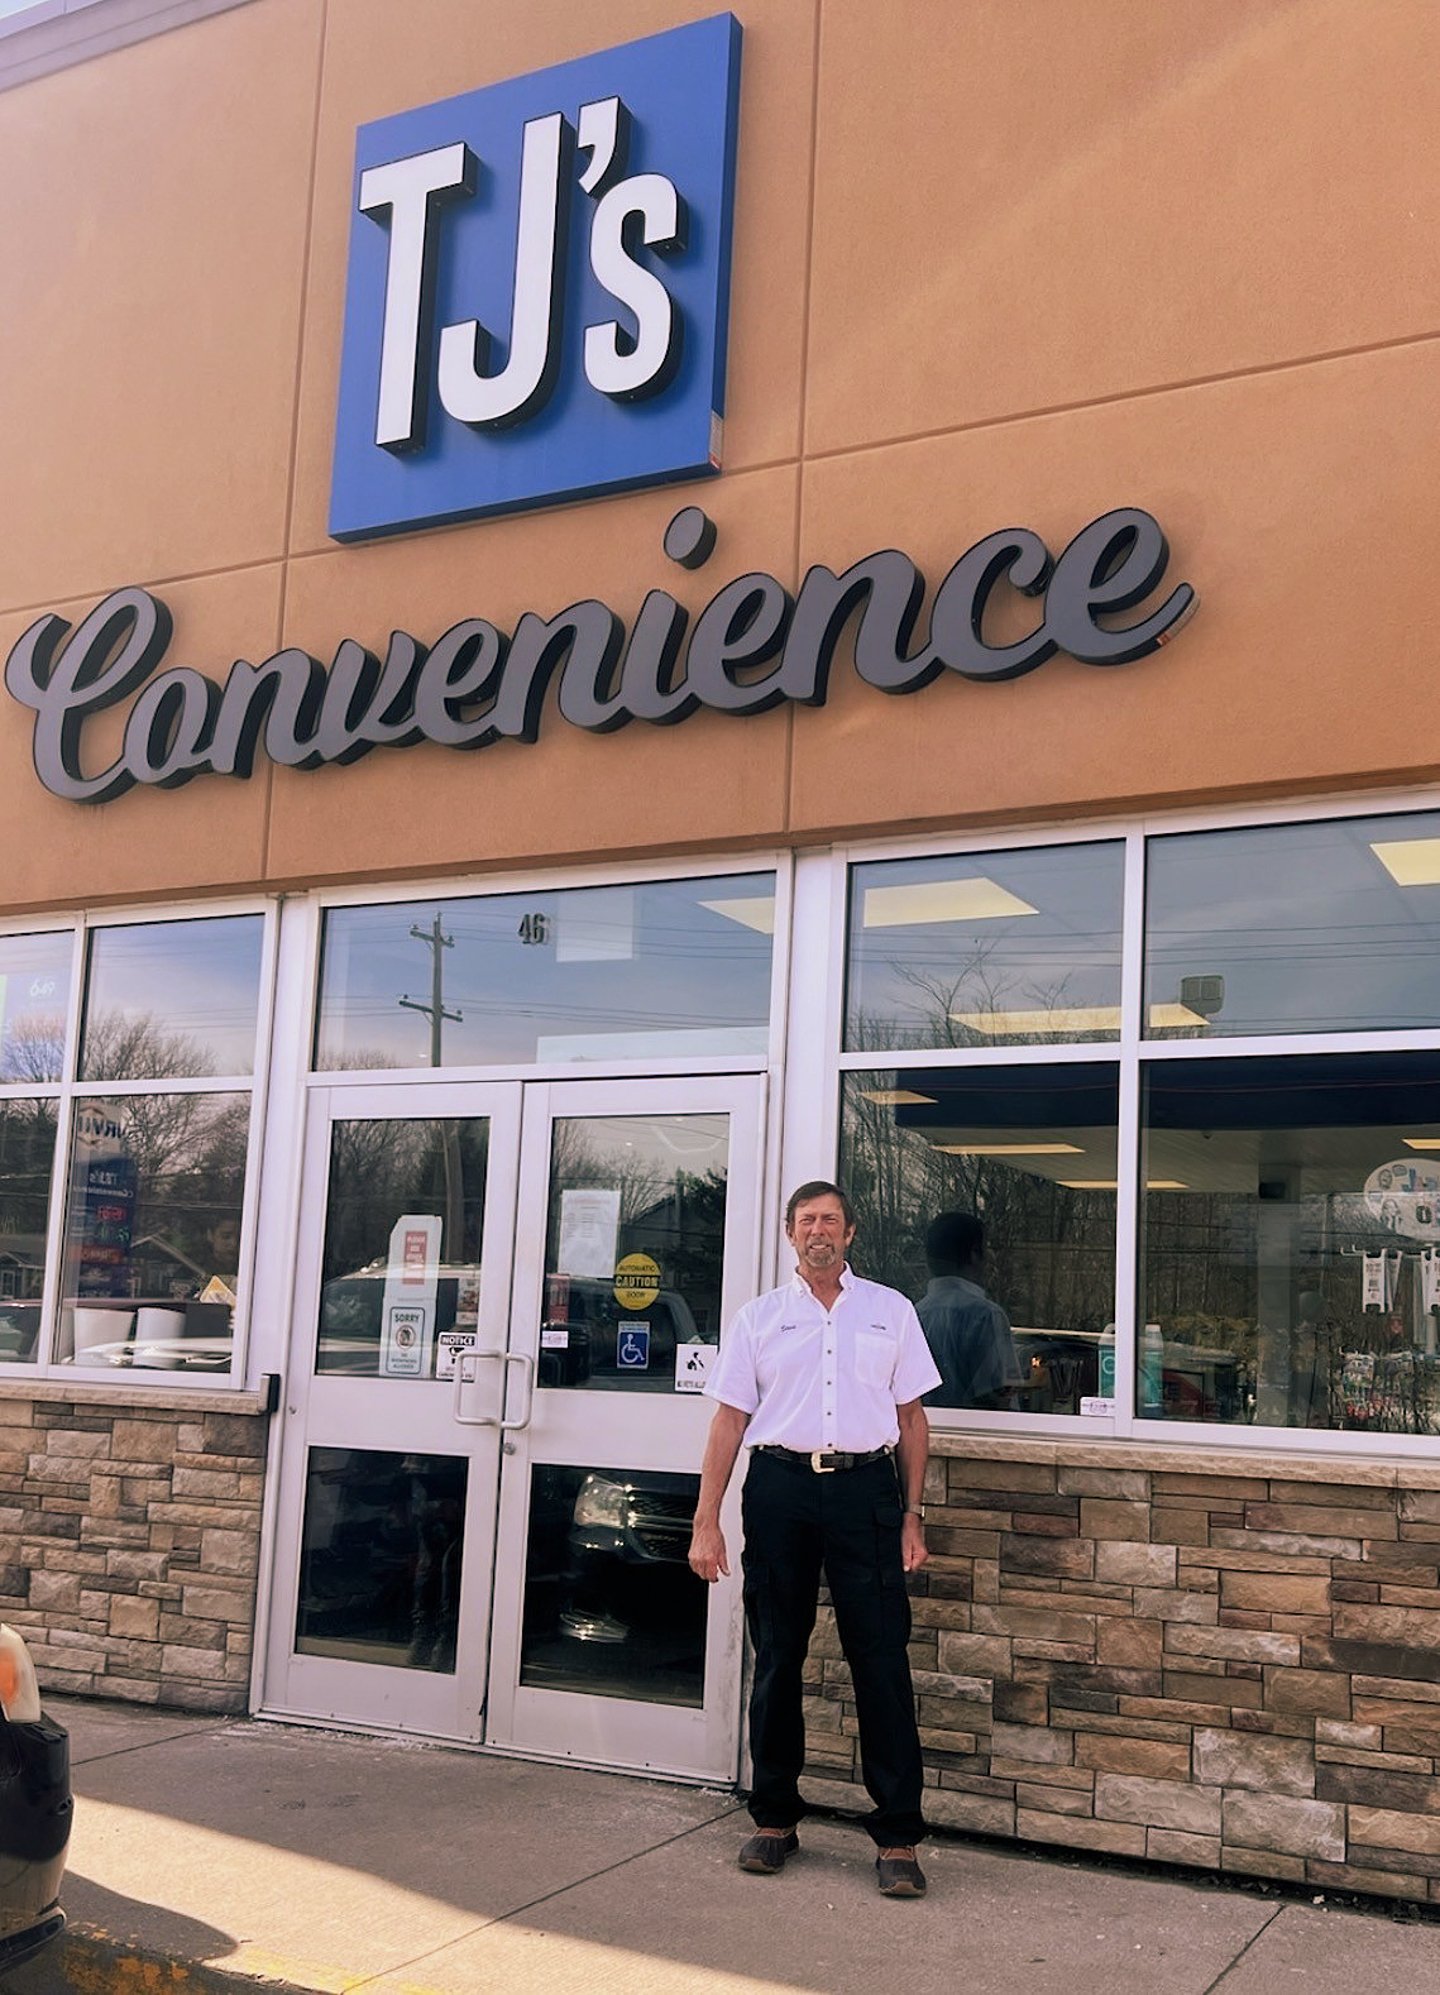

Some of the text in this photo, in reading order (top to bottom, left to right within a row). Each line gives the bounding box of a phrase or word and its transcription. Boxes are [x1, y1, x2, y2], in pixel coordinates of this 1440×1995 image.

[358, 96, 687, 453] TJ's
[5, 506, 1198, 803] Convenience
[517, 912, 548, 945] 46
[615, 1276, 658, 1288] CAUTION
[394, 1312, 420, 1324] SORRY
[441, 1336, 473, 1346] NOTICE
